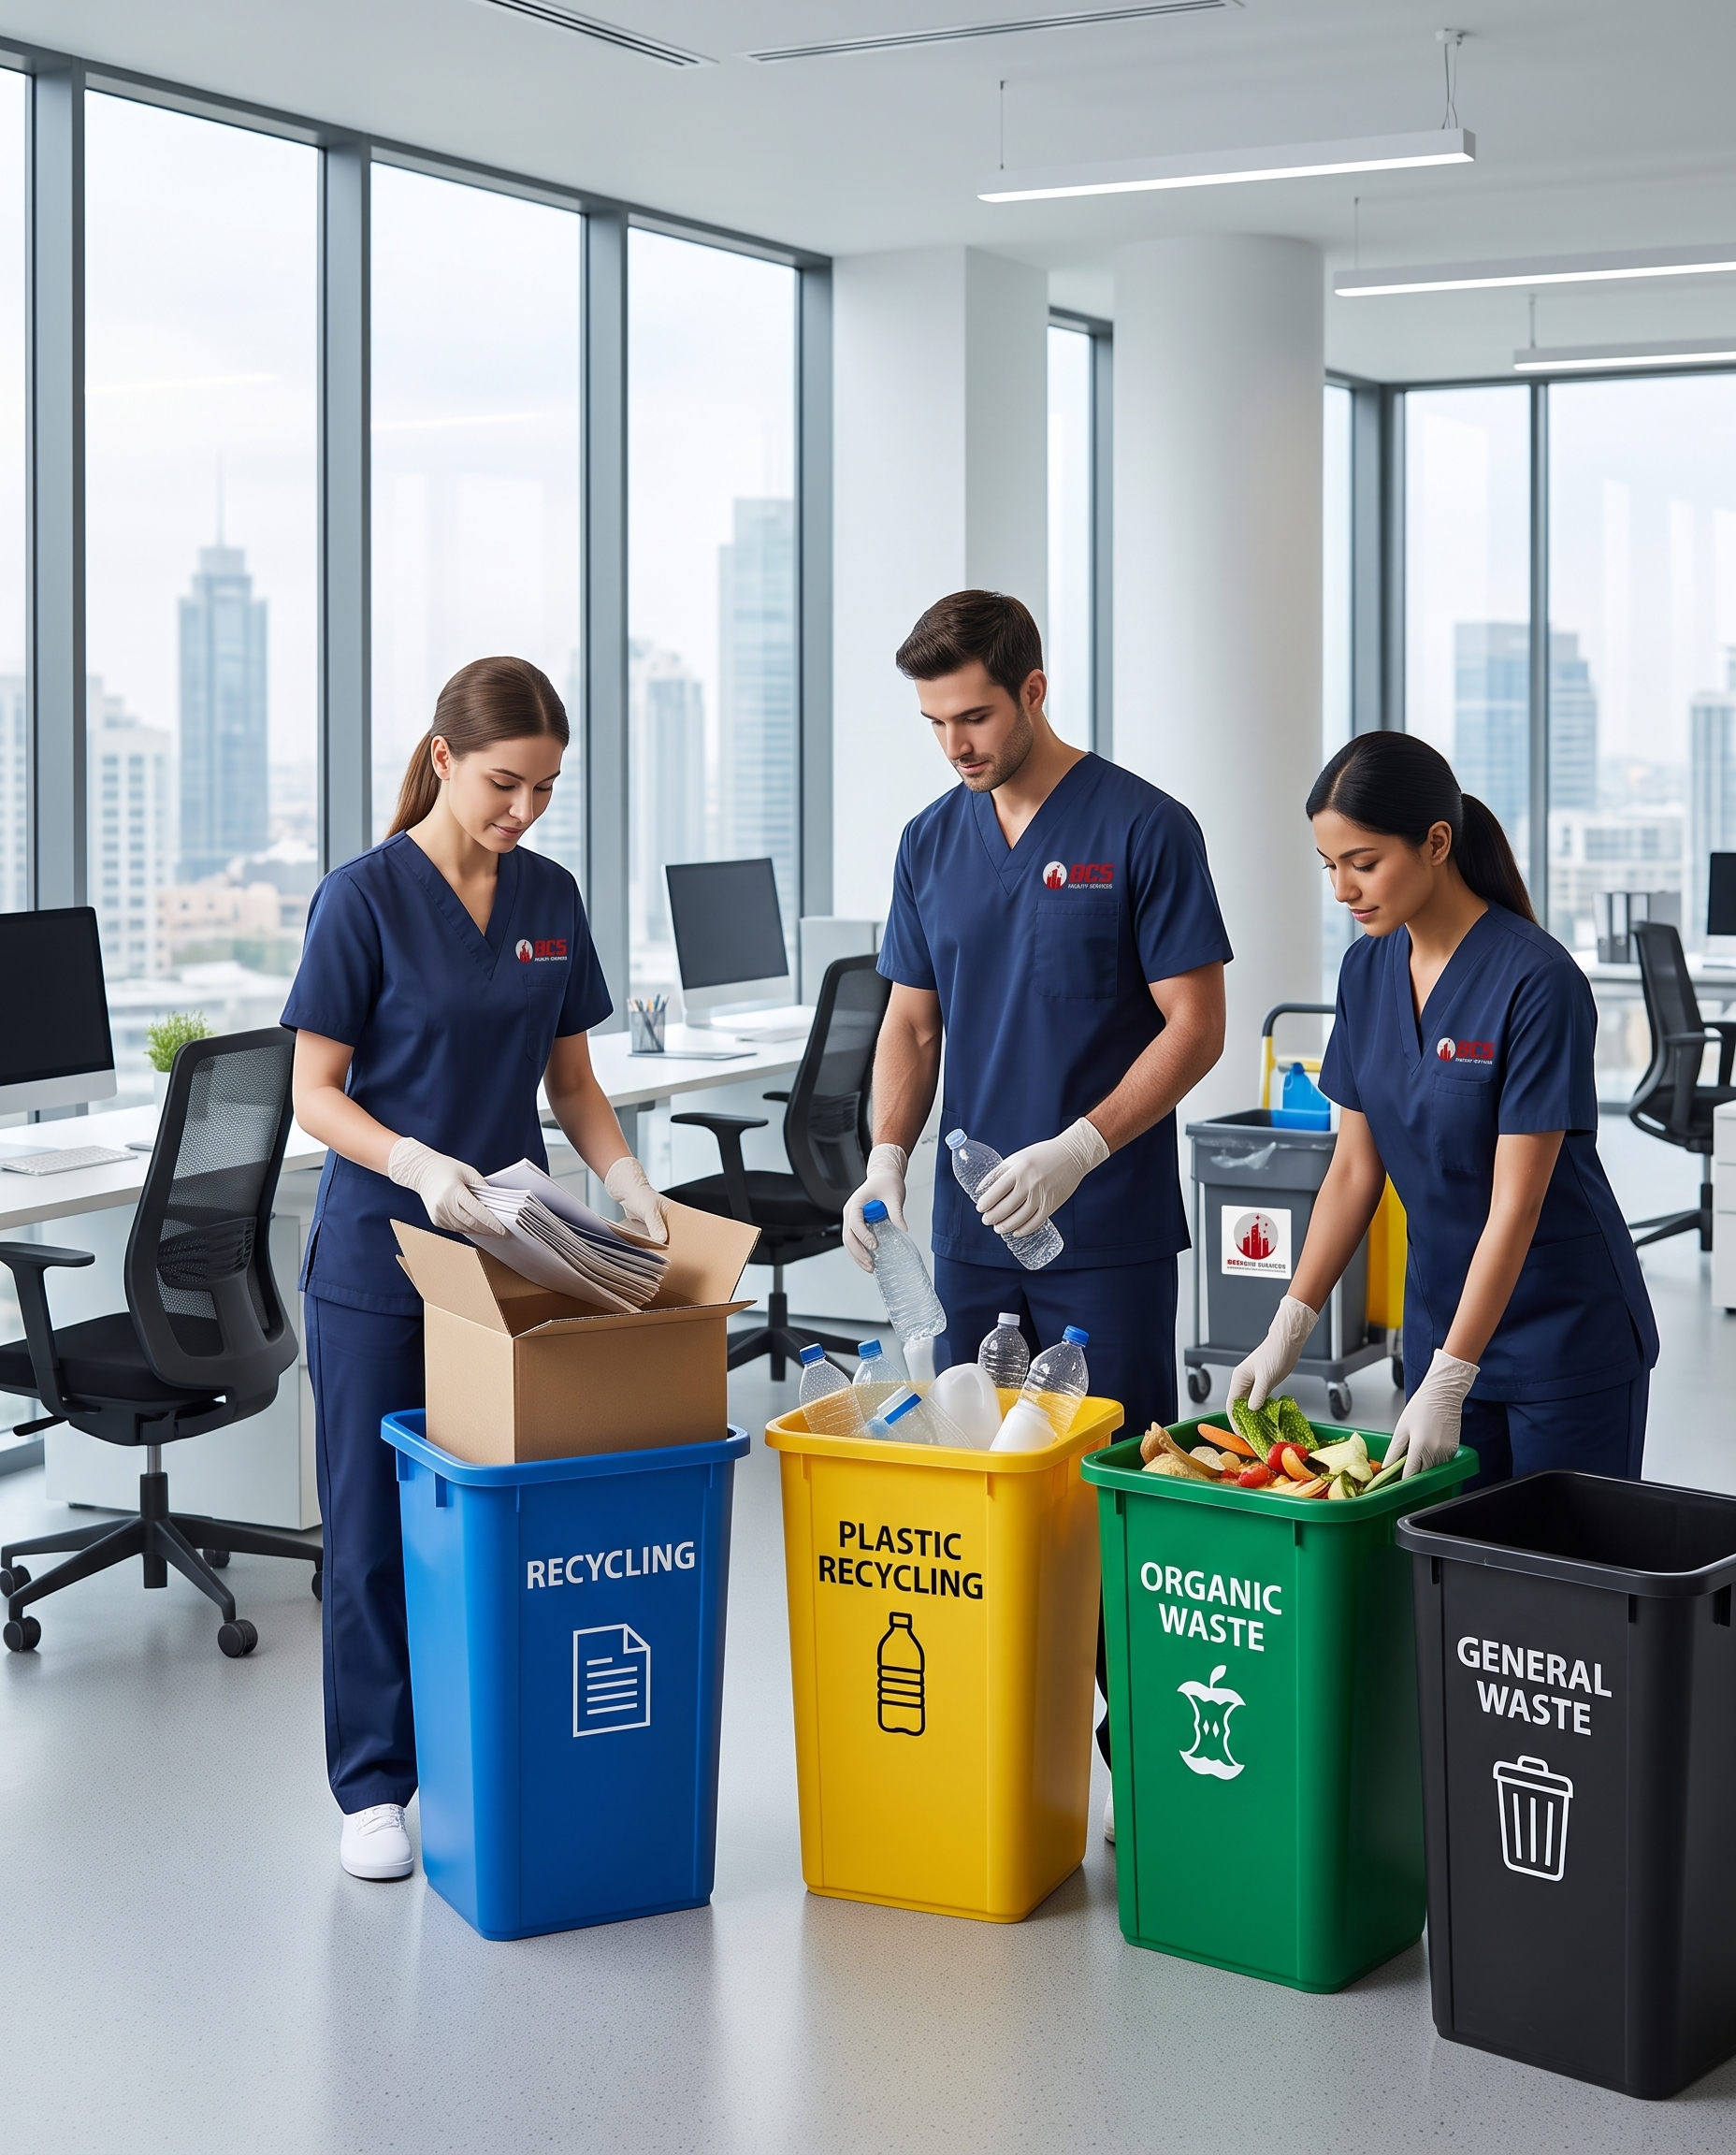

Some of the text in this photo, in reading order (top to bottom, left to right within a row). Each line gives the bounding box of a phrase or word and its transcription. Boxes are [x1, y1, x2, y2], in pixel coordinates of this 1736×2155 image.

[1068, 863, 1115, 883] BCS
[534, 939, 568, 957] BCS
[1456, 1040, 1496, 1060] BCS
[840, 1521, 962, 1560] PLASTIC
[527, 1541, 695, 1589] RECYCLING
[818, 1555, 984, 1599] RECYCLING
[1140, 1561, 1282, 1615] ORGANIC
[1158, 1603, 1265, 1652] WASTE
[1456, 1636, 1613, 1698] GENERAL
[1476, 1680, 1592, 1736] WASTE
